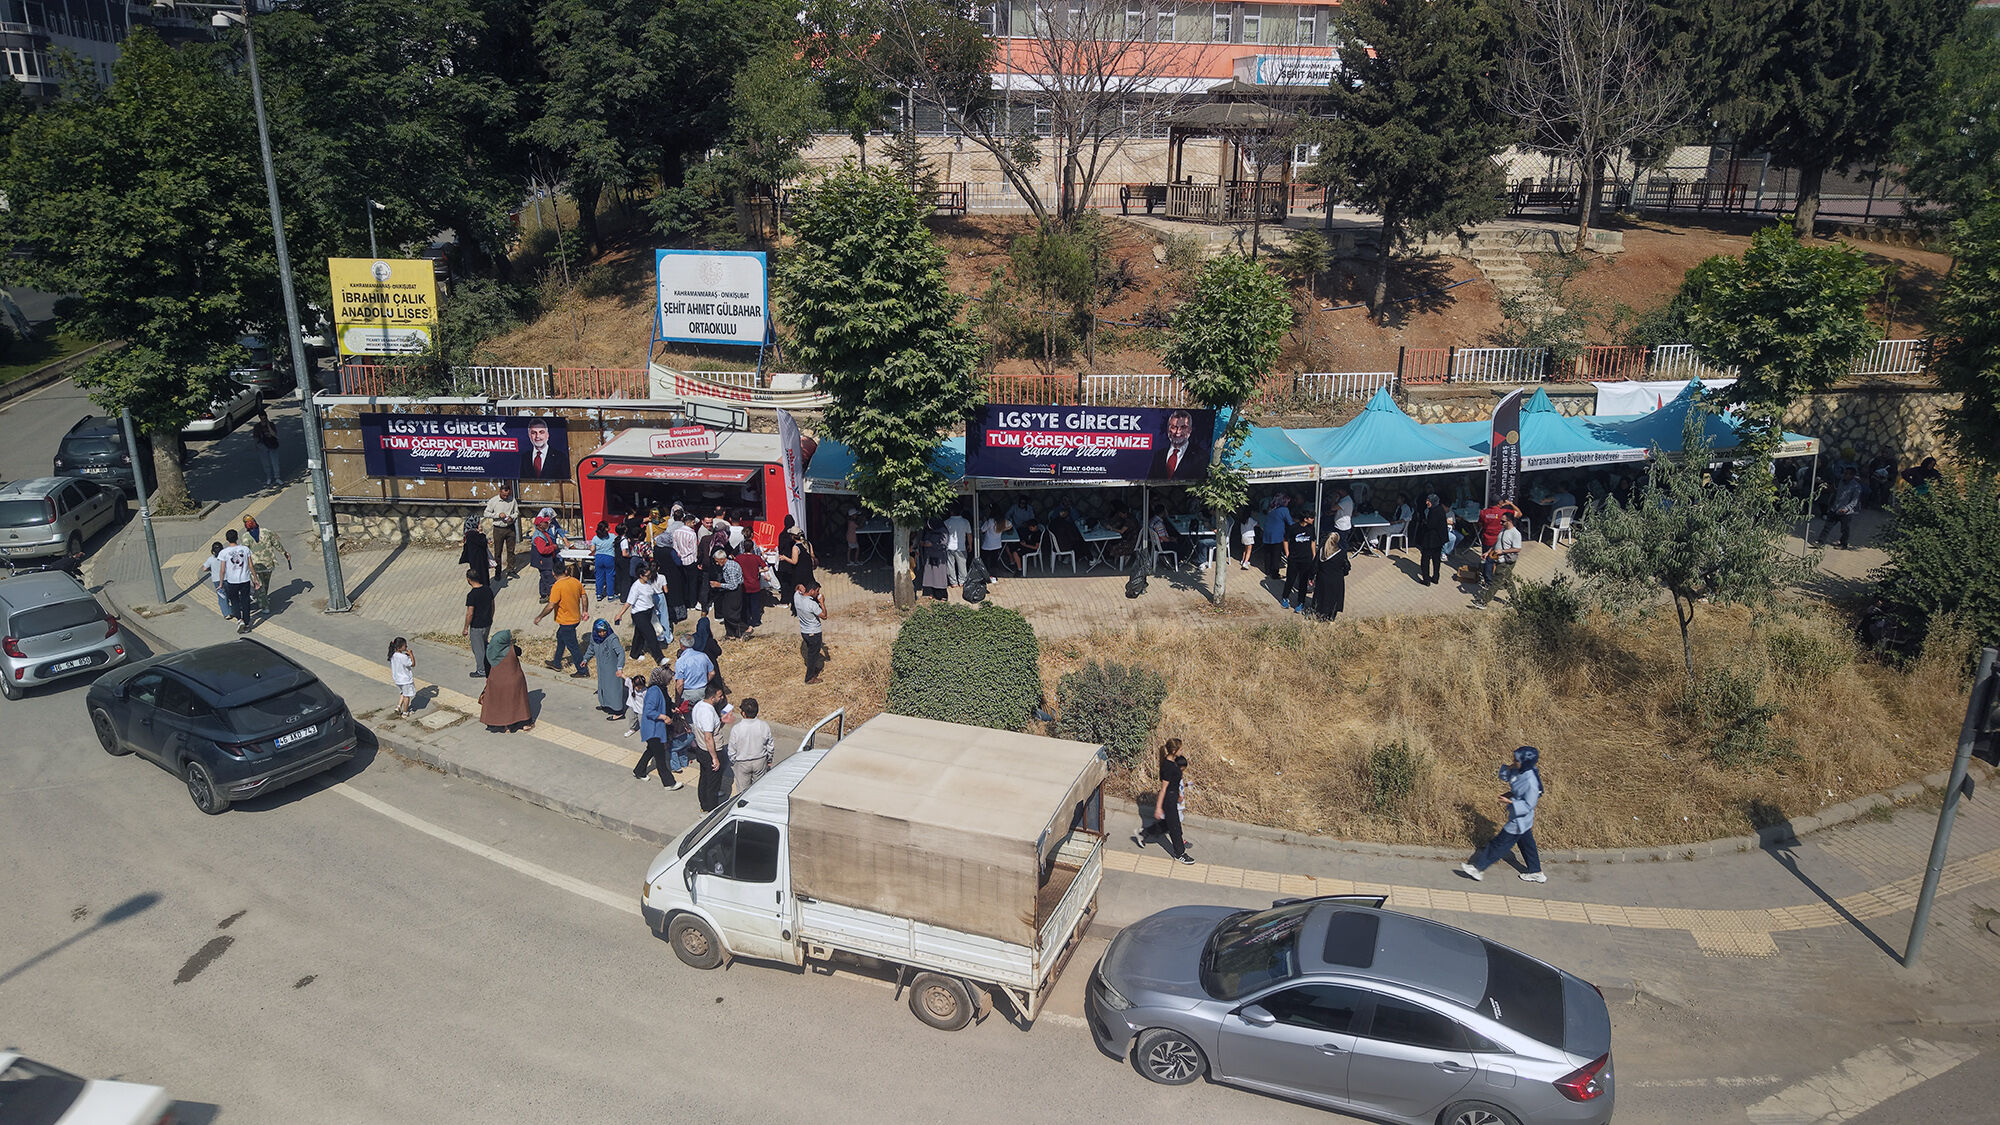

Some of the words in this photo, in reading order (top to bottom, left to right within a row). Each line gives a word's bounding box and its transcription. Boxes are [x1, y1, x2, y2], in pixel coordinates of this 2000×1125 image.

[341, 289, 390, 304] İBRAHİM
[393, 293, 427, 307] ÇALIK
[674, 290, 718, 299] KAHRAMANMARAŞ
[341, 307, 394, 318] ANADOLU
[663, 300, 686, 317] ŞEHİT
[687, 303, 715, 315] AHMET
[716, 301, 762, 317] GÜLBAHAR
[688, 321, 737, 335] ORTAOKULU
[387, 418, 440, 435] LGS'YE
[443, 418, 508, 436] GİRECEK
[998, 411, 1060, 429] LGS'YE
[1065, 410, 1142, 431] GİRECEK
[382, 436, 409, 449] TÜM
[411, 436, 517, 450] ÖĞRENCİLERİMİZE
[989, 431, 1020, 446] TÜM
[1023, 431, 1150, 448] ÖĞRENCİLERİMİZE
[410, 446, 454, 459] Başarılar
[456, 448, 491, 459] Dilerim
[1020, 443, 1074, 458] Başarılar
[1076, 445, 1118, 458] Dilerim
[1527, 456, 1567, 467] Kahramanmaraş
[1567, 453, 1595, 463] Büyükşehir
[1595, 452, 1620, 461] Belediyesi
[1081, 464, 1107, 472] GÖRGEL
[1399, 462, 1427, 474] Büyükşehir
[1427, 461, 1454, 471] Belediyesi
